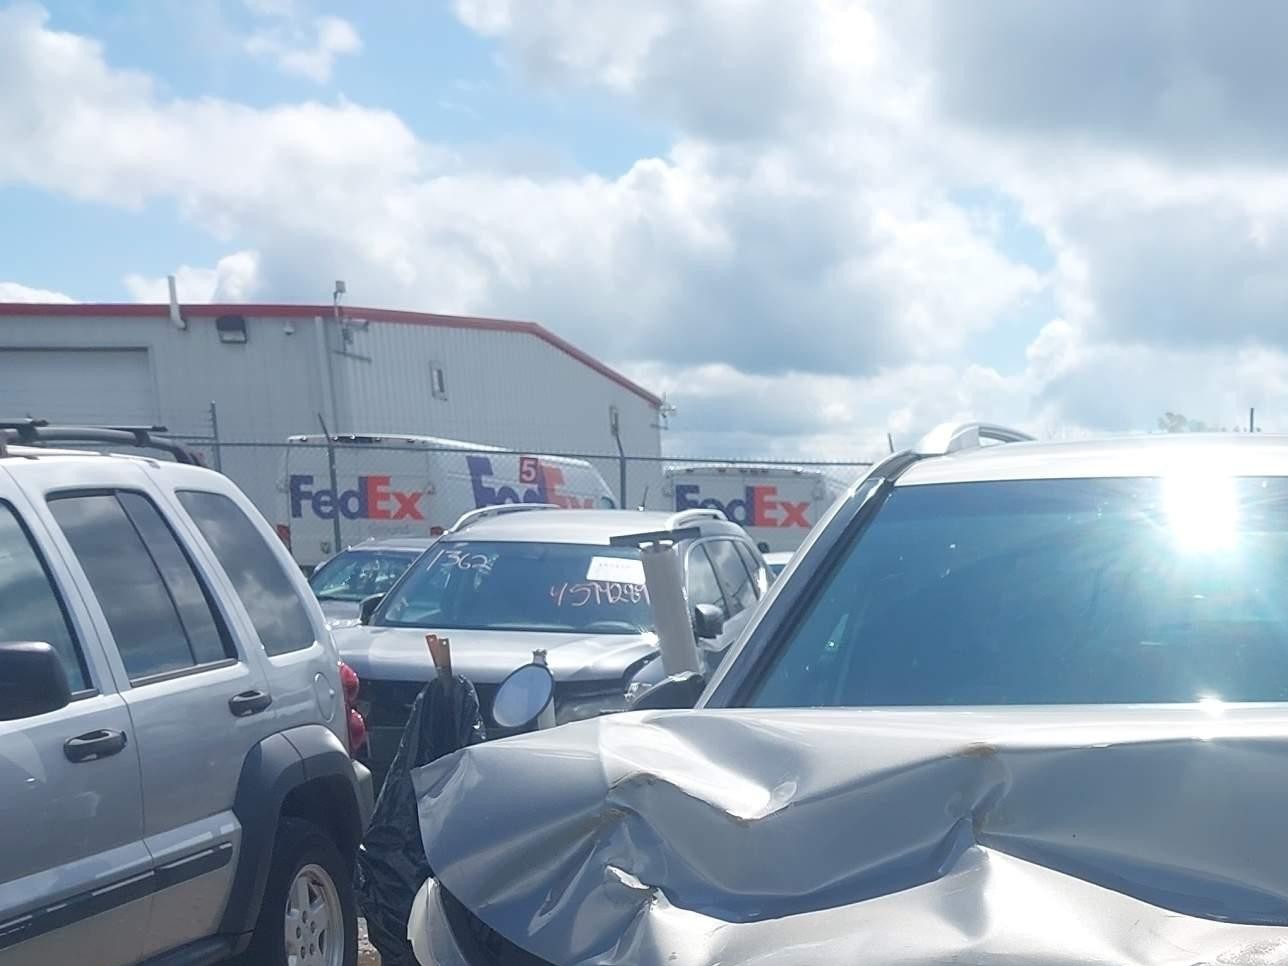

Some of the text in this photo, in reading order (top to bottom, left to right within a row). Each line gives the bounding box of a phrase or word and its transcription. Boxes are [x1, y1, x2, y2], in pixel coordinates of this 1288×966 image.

[521, 458, 536, 481] 5
[290, 475, 425, 520] FedEx
[426, 548, 491, 571] 1362
